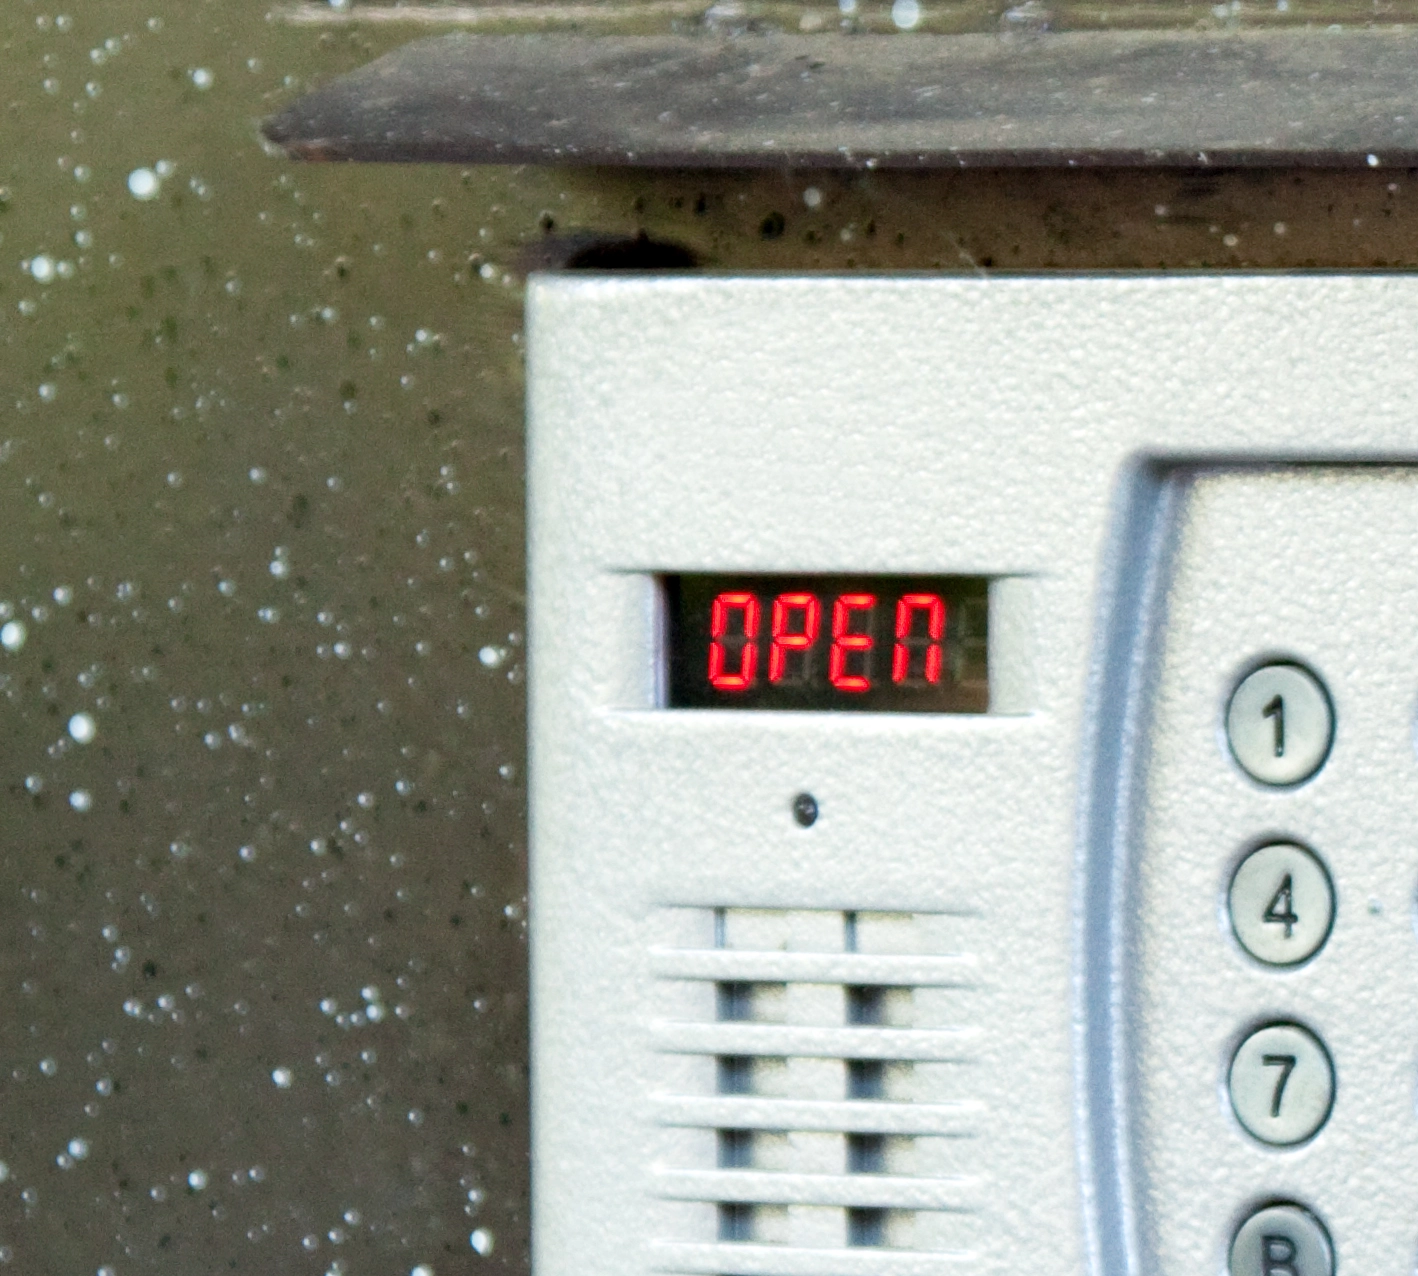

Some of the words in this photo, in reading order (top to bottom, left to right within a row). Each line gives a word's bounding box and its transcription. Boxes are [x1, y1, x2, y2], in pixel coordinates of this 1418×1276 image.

[707, 591, 946, 692] OPEN
[1261, 693, 1286, 758] 1
[1262, 872, 1299, 940] 4
[1261, 1054, 1298, 1118] 7
